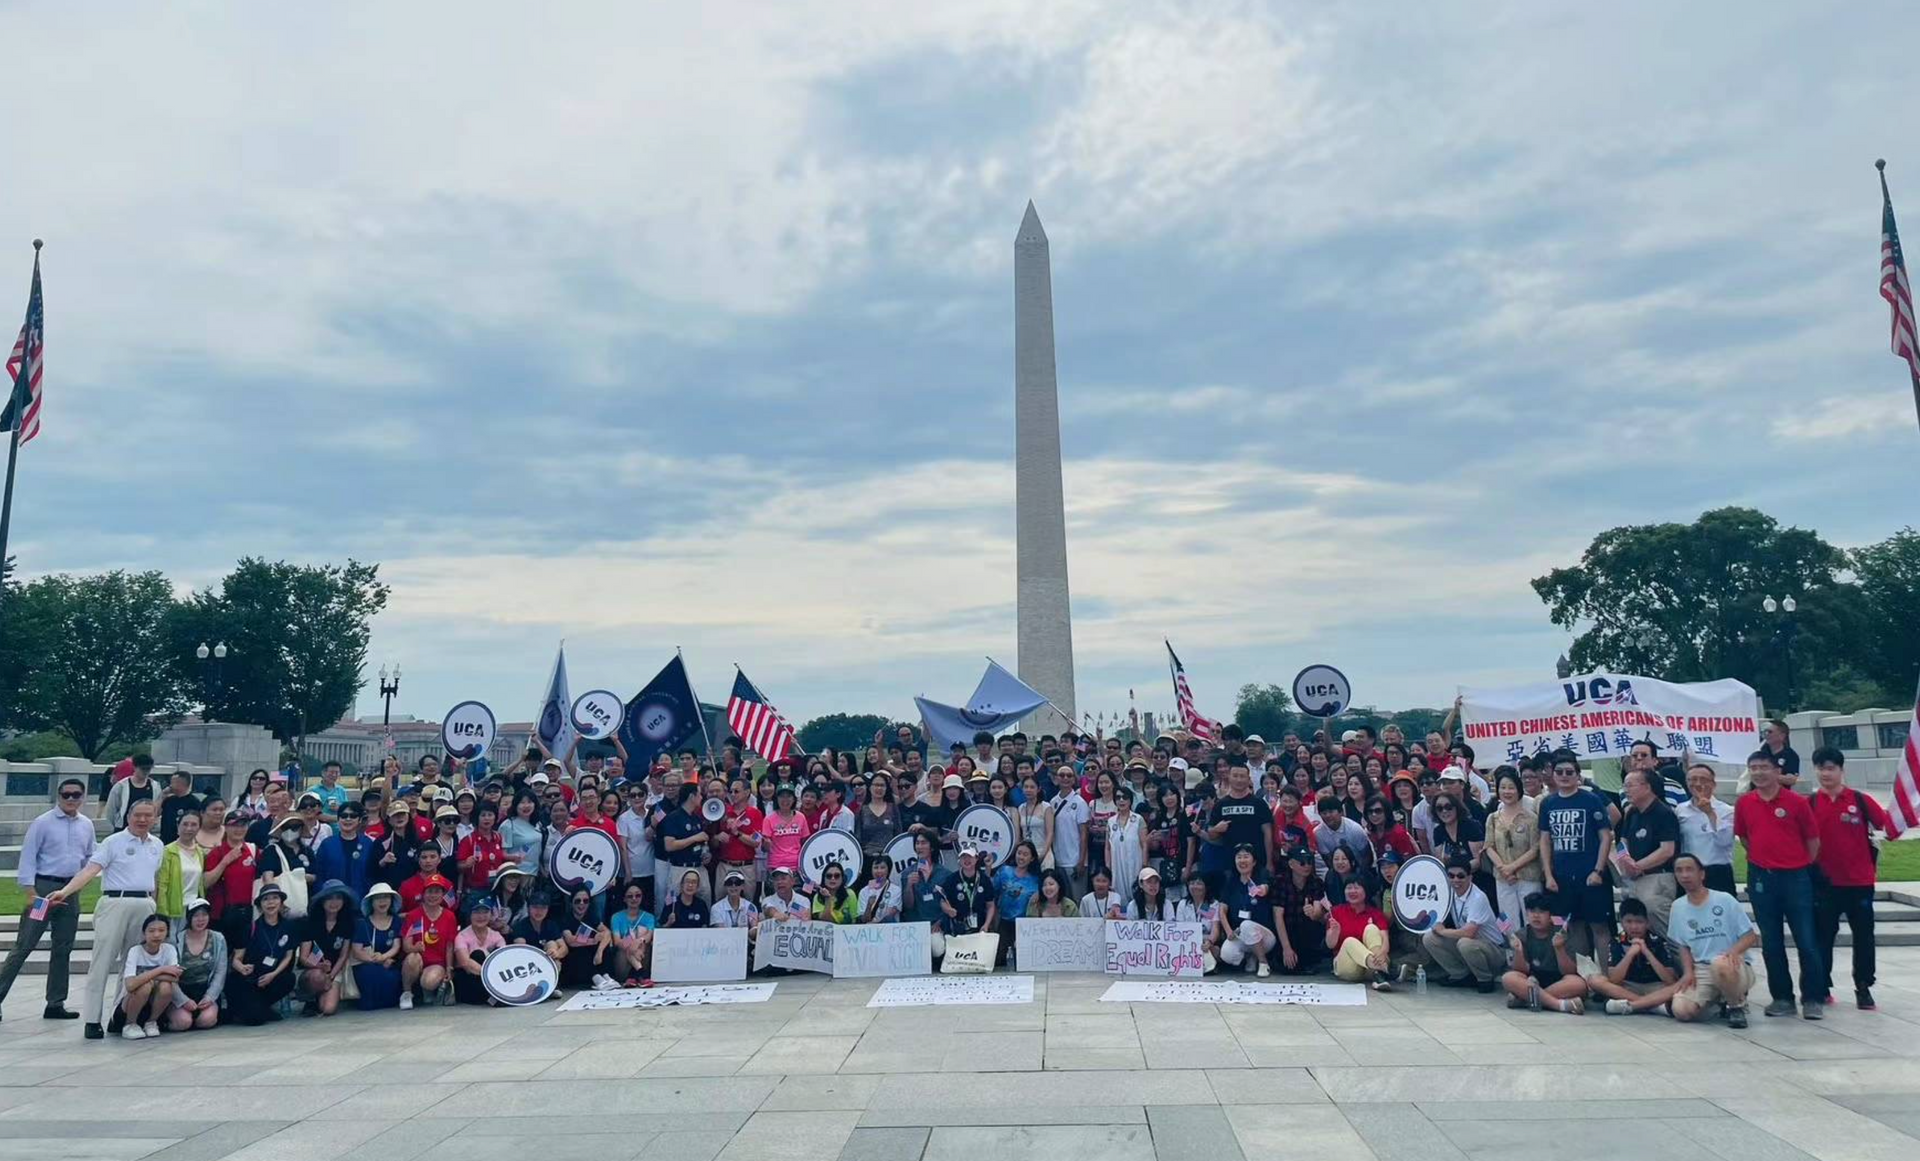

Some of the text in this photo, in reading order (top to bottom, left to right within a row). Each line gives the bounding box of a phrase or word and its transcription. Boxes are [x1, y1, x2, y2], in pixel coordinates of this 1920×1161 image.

[1305, 683, 1339, 697] UCA
[1563, 677, 1639, 707] UCA
[585, 701, 611, 726] UCA
[647, 714, 666, 731] UCA
[454, 722, 484, 737] UCA
[1465, 710, 1755, 739] UNITED CHINESE AMERICANS OF ARIZONA
[1549, 811, 1580, 824] STOP
[1552, 824, 1583, 837] SIAN
[568, 847, 604, 876] UCA
[812, 848, 849, 870] UCA
[895, 857, 918, 874] UC
[1405, 883, 1438, 901] UCA
[842, 926, 884, 945] WALK
[891, 925, 918, 942] FOR
[1114, 922, 1194, 941] Walk For
[773, 933, 833, 963] EQUAL
[955, 951, 978, 961] UCA
[1031, 940, 1100, 967] DREAM
[1106, 942, 1202, 976] Equal Rights
[499, 962, 542, 983] UCA
